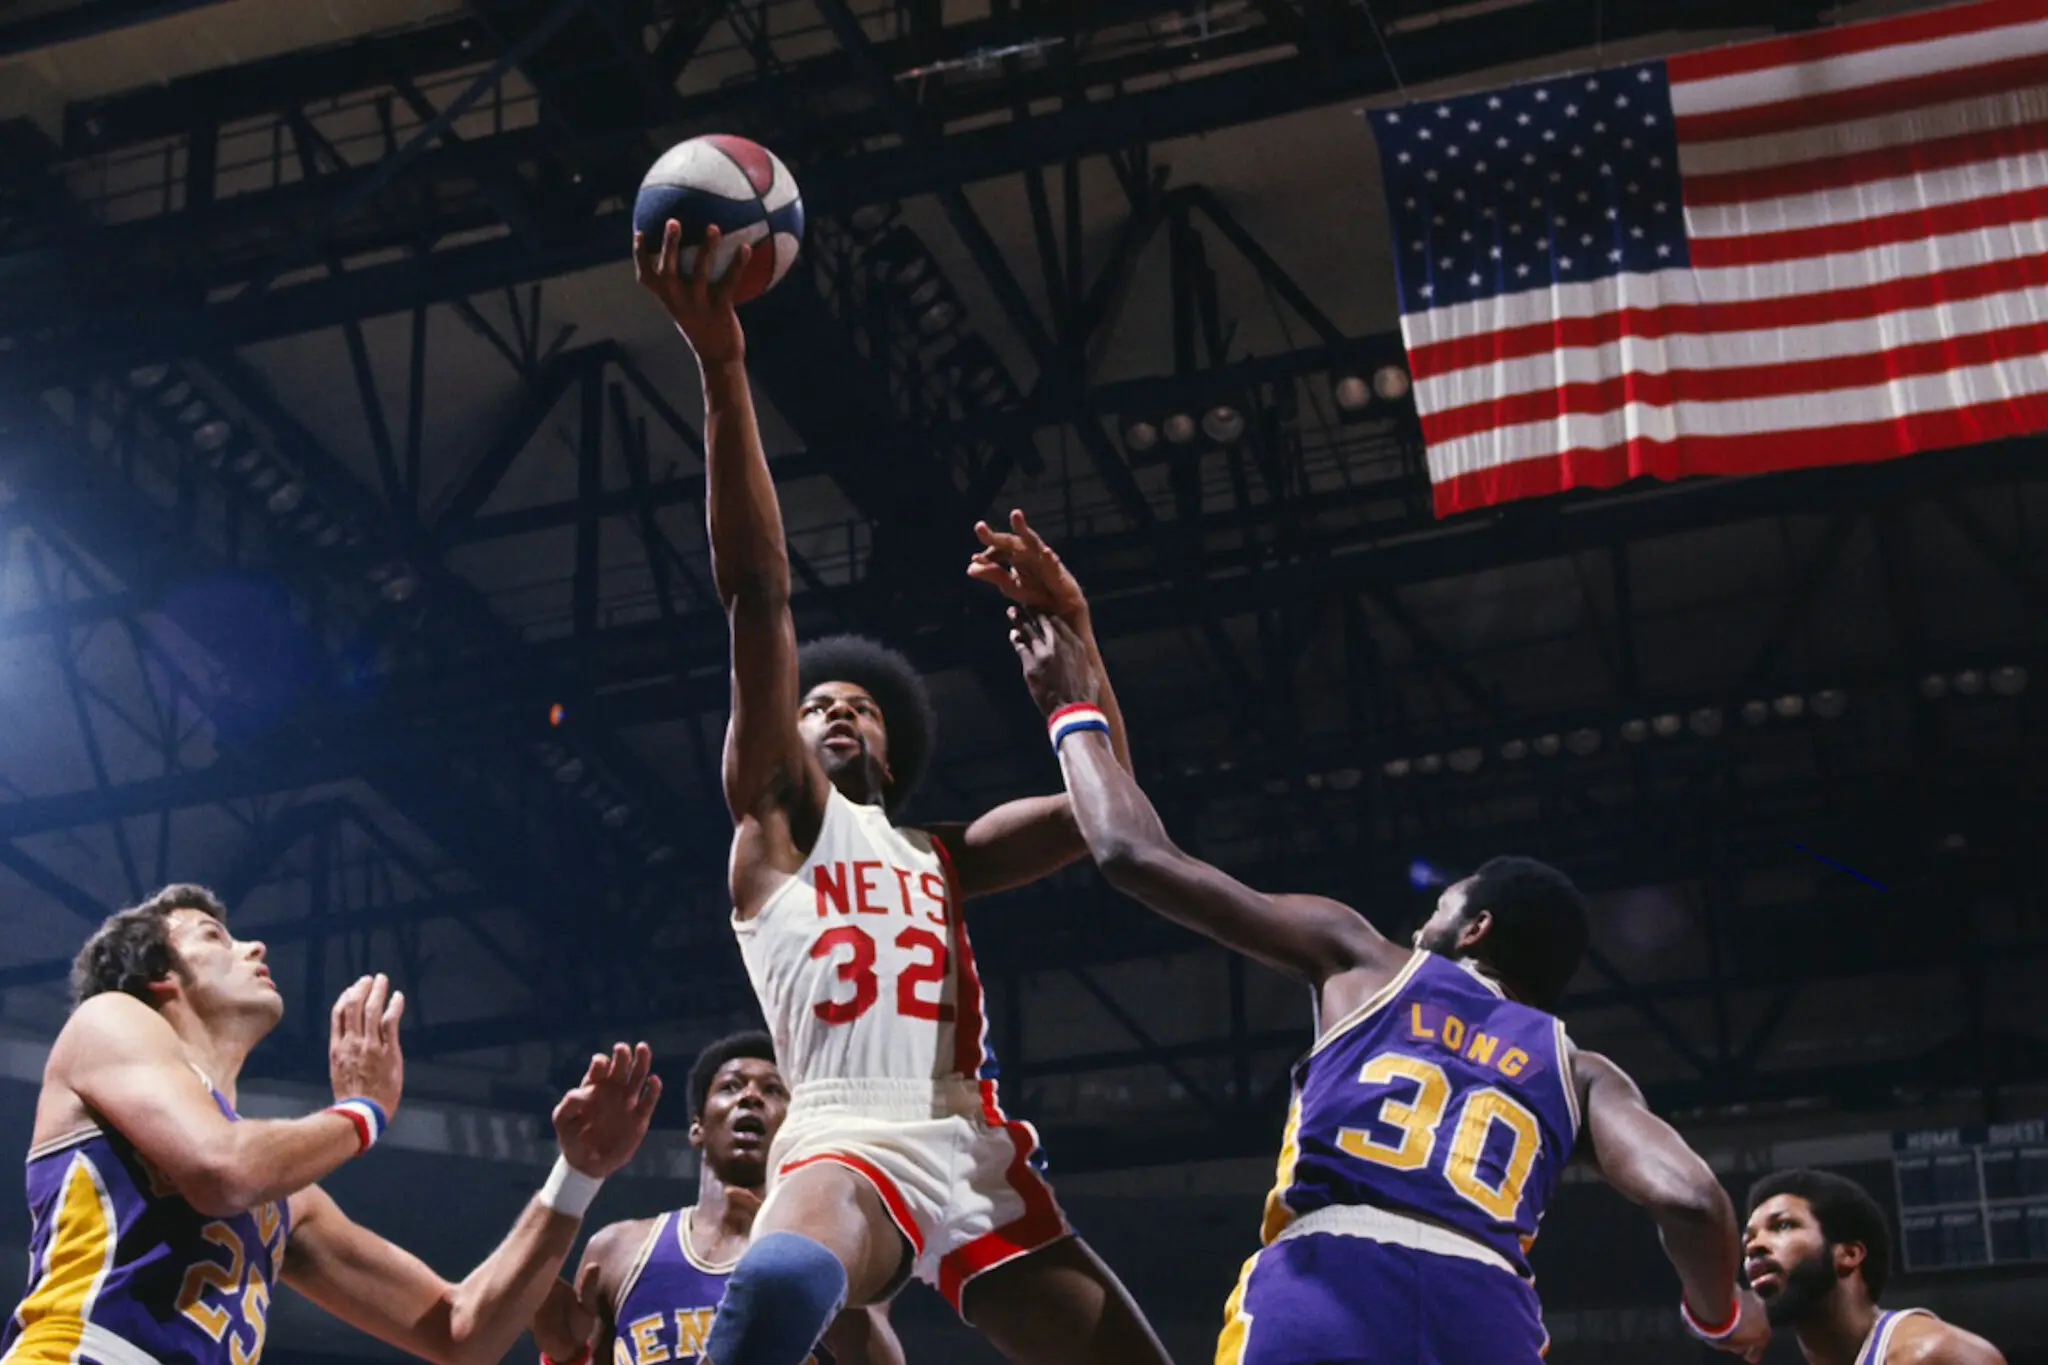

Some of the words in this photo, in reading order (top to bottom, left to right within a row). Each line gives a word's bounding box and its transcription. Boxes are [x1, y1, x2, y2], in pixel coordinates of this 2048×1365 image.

[813, 861, 949, 926] NETS
[809, 925, 954, 1025] 32
[1411, 1003, 1529, 1077] LONG
[1335, 1051, 1541, 1222] 30
